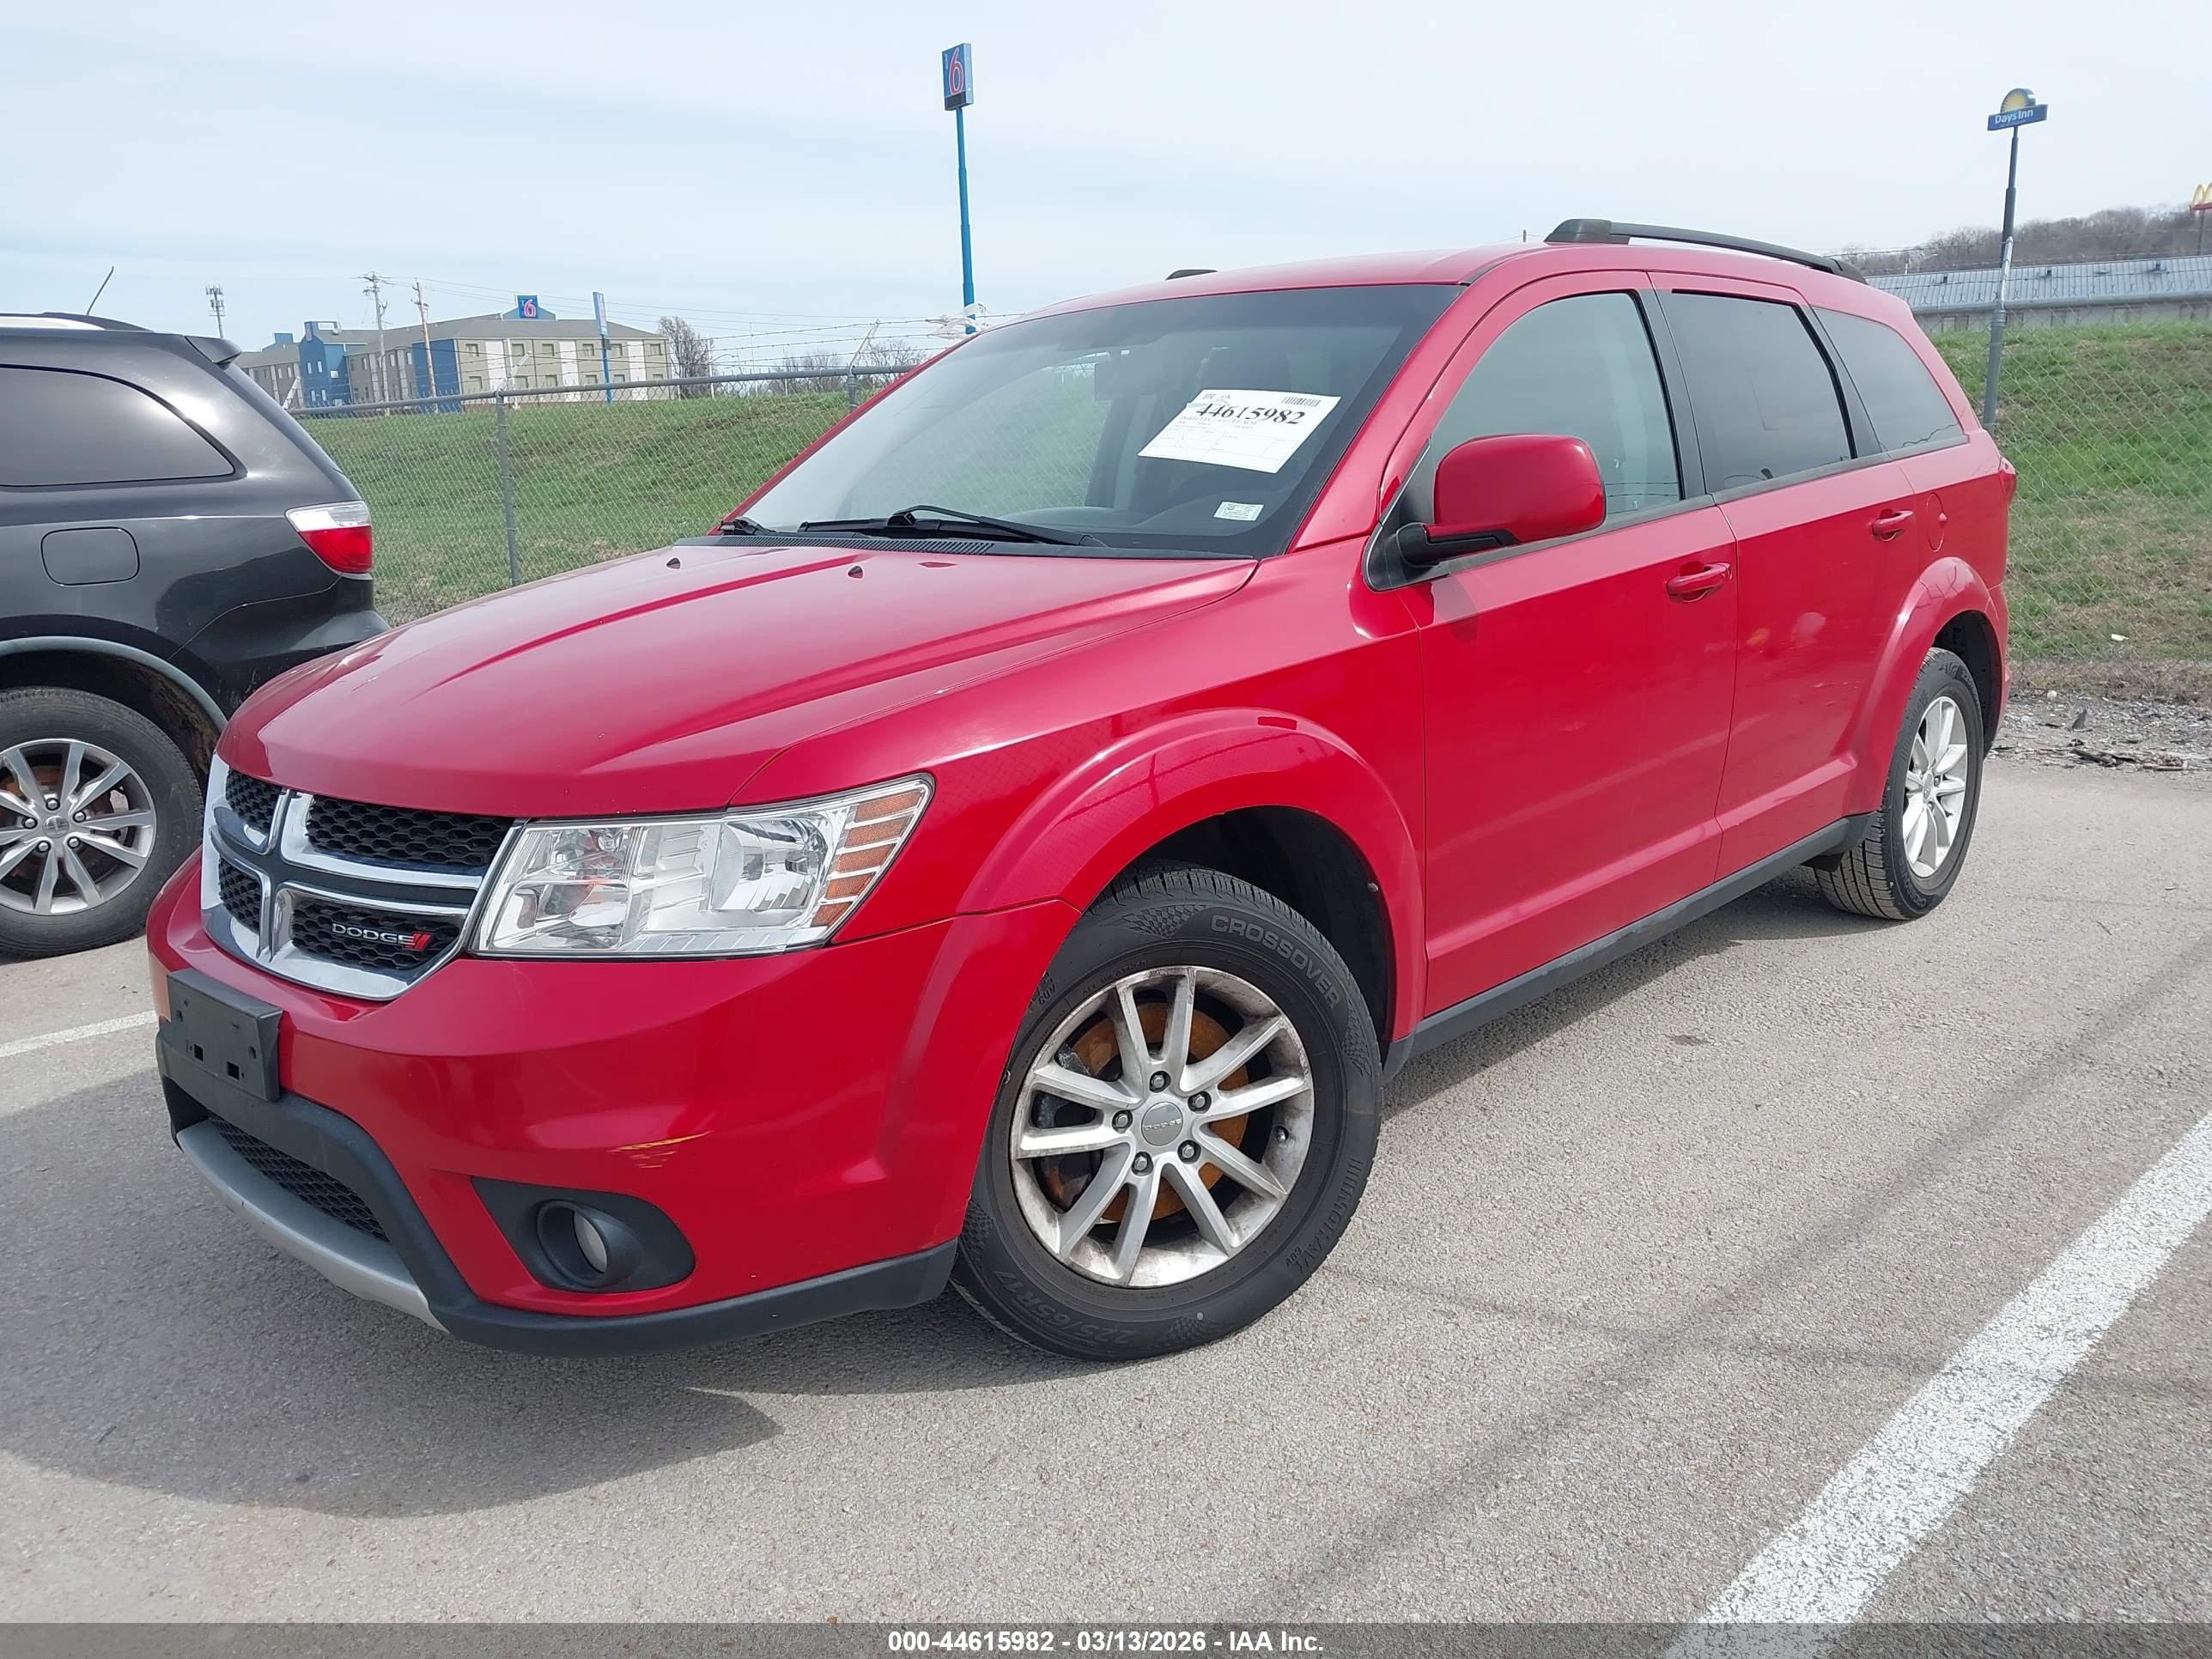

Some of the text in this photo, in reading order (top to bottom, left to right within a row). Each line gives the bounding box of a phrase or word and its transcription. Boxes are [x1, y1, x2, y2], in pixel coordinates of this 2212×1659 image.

[949, 46, 963, 95] 6
[1995, 109, 2033, 124] Days Inn
[523, 298, 536, 318] 6
[1196, 404, 1305, 424] 44615982
[331, 923, 416, 945] DODGE
[1211, 915, 1340, 1009] CROSSOVER
